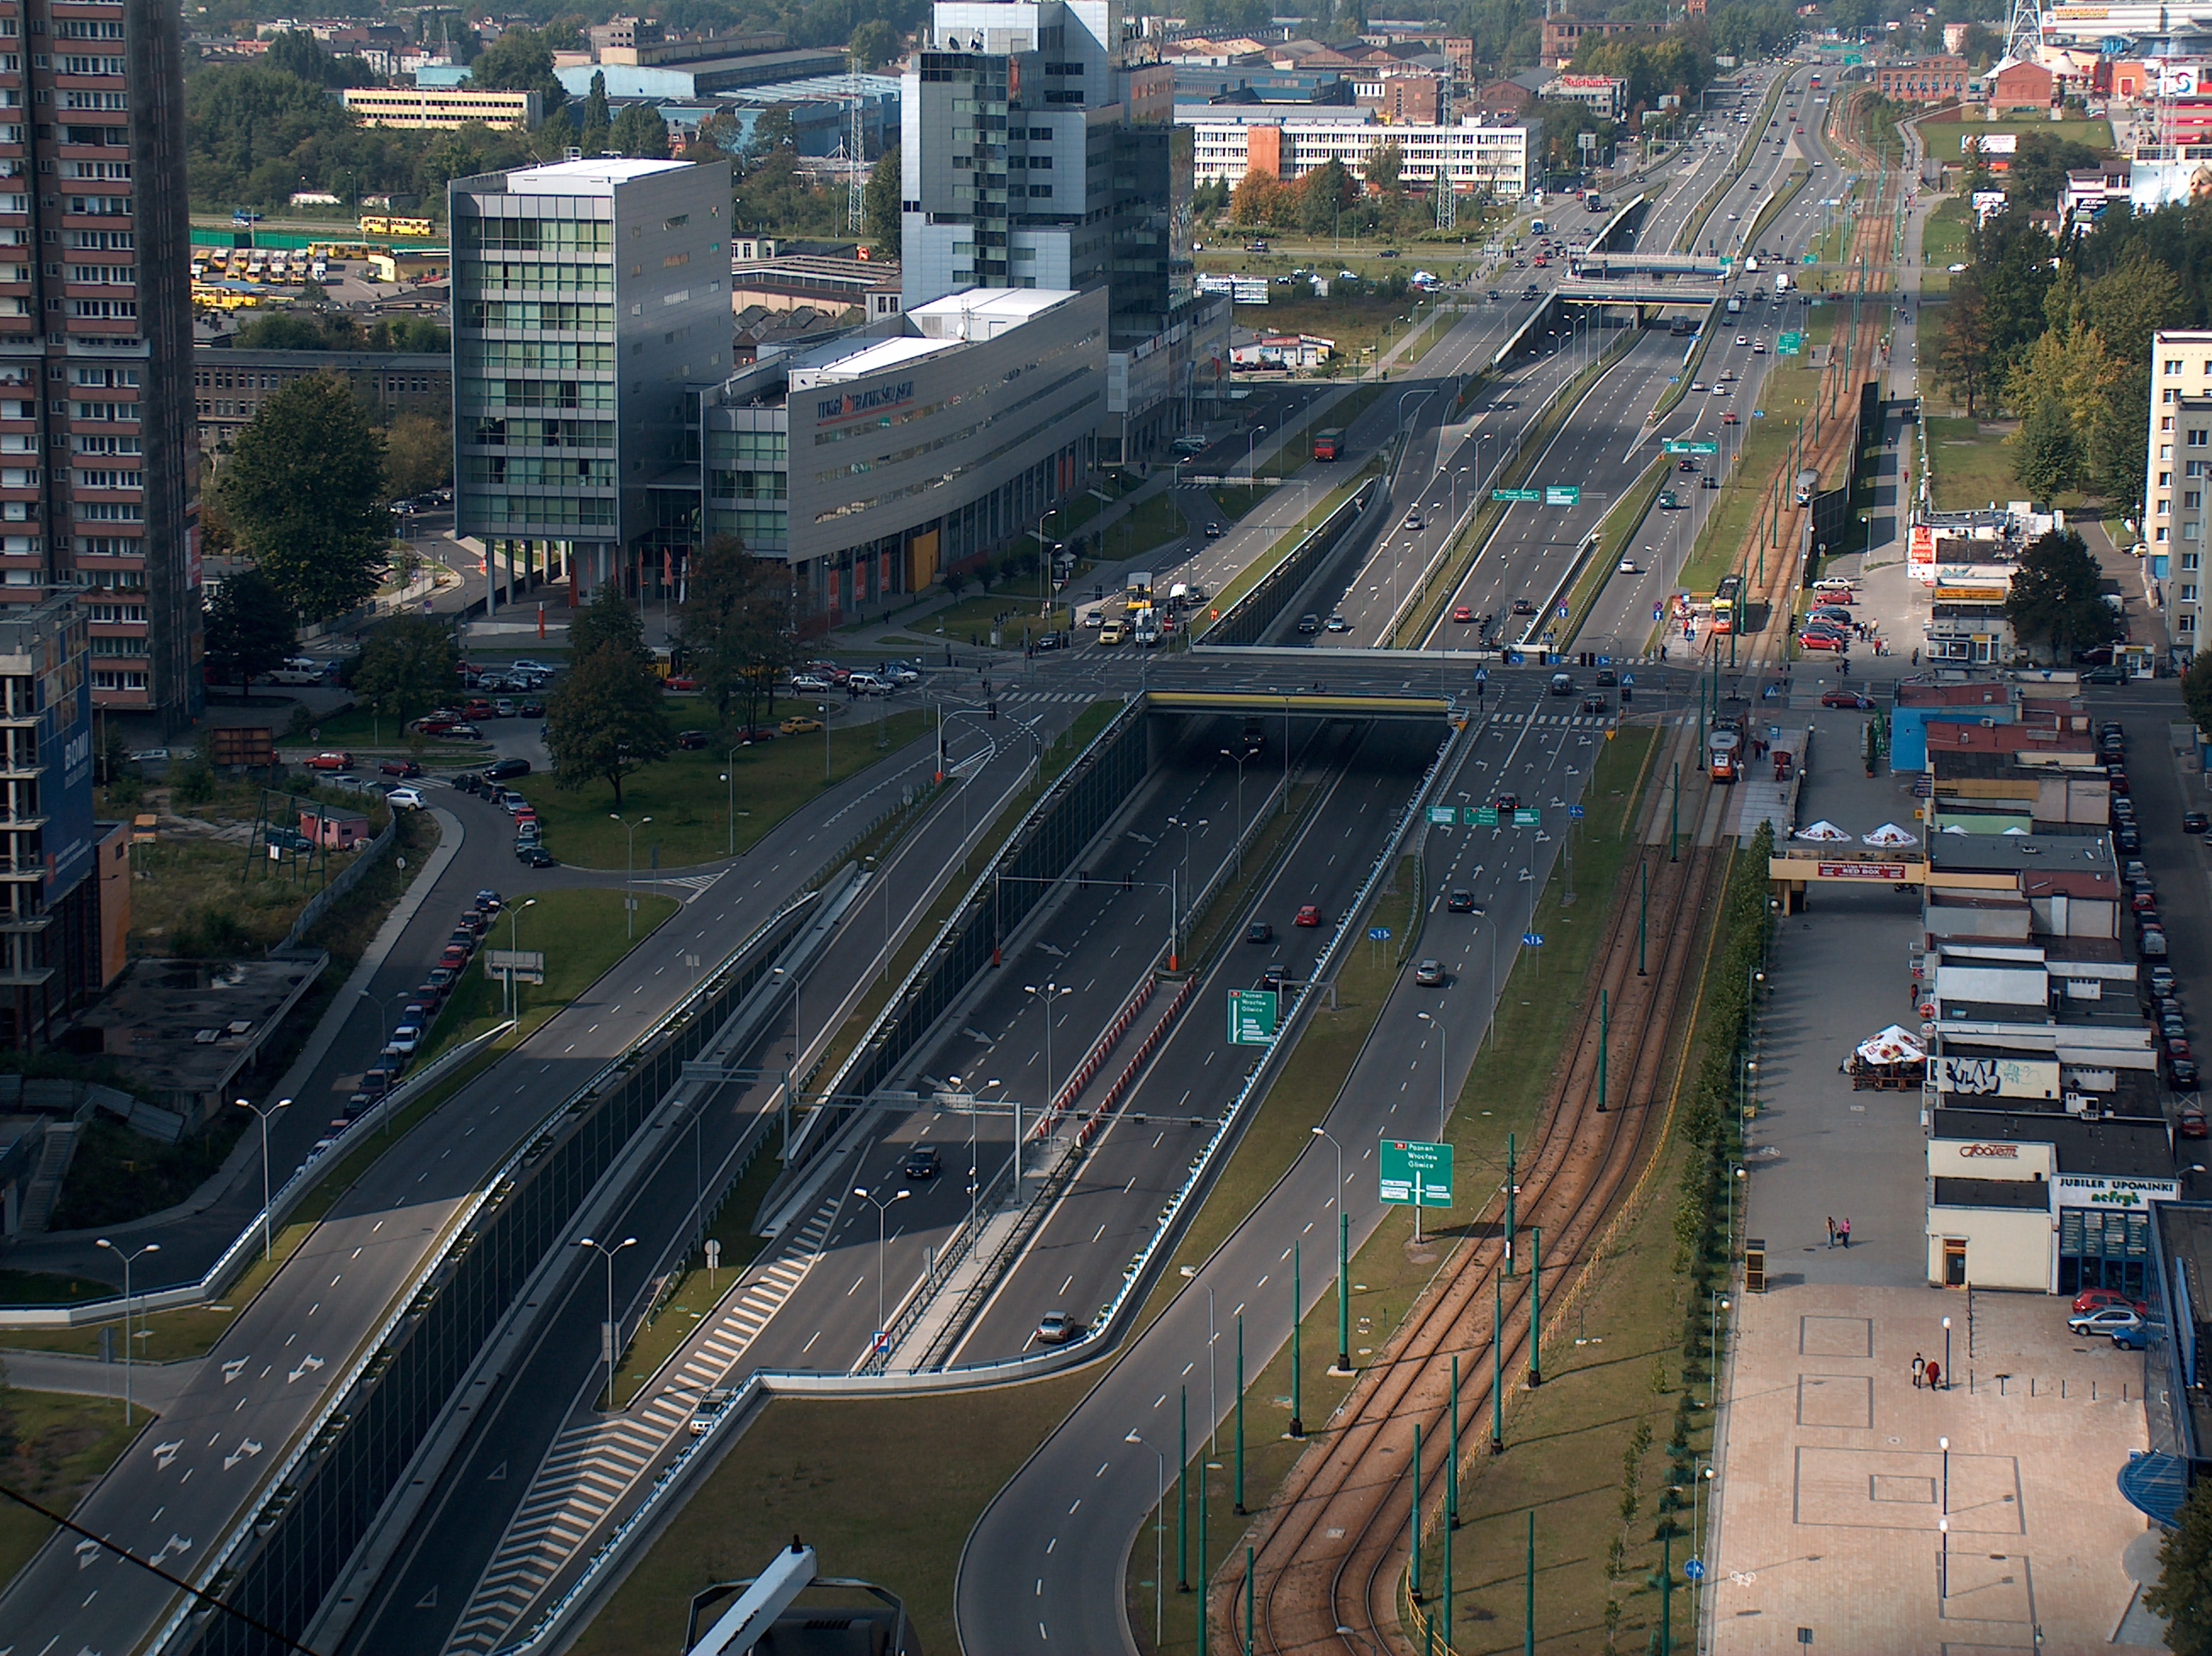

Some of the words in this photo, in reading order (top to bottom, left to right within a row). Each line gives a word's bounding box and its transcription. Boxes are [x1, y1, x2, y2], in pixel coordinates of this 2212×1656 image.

[1561, 76, 1602, 87] Auchan
[1883, 81, 1962, 92] SILESIA
[818, 394, 842, 419] ING
[853, 389, 881, 411] BANK
[64, 730, 89, 772] BOMI
[1408, 1151, 1438, 1161] Wrocław
[1408, 1161, 1435, 1169] Gliwice
[2059, 1178, 2106, 1189] JUBILER
[2111, 1180, 2174, 1192] UPOMINKI
